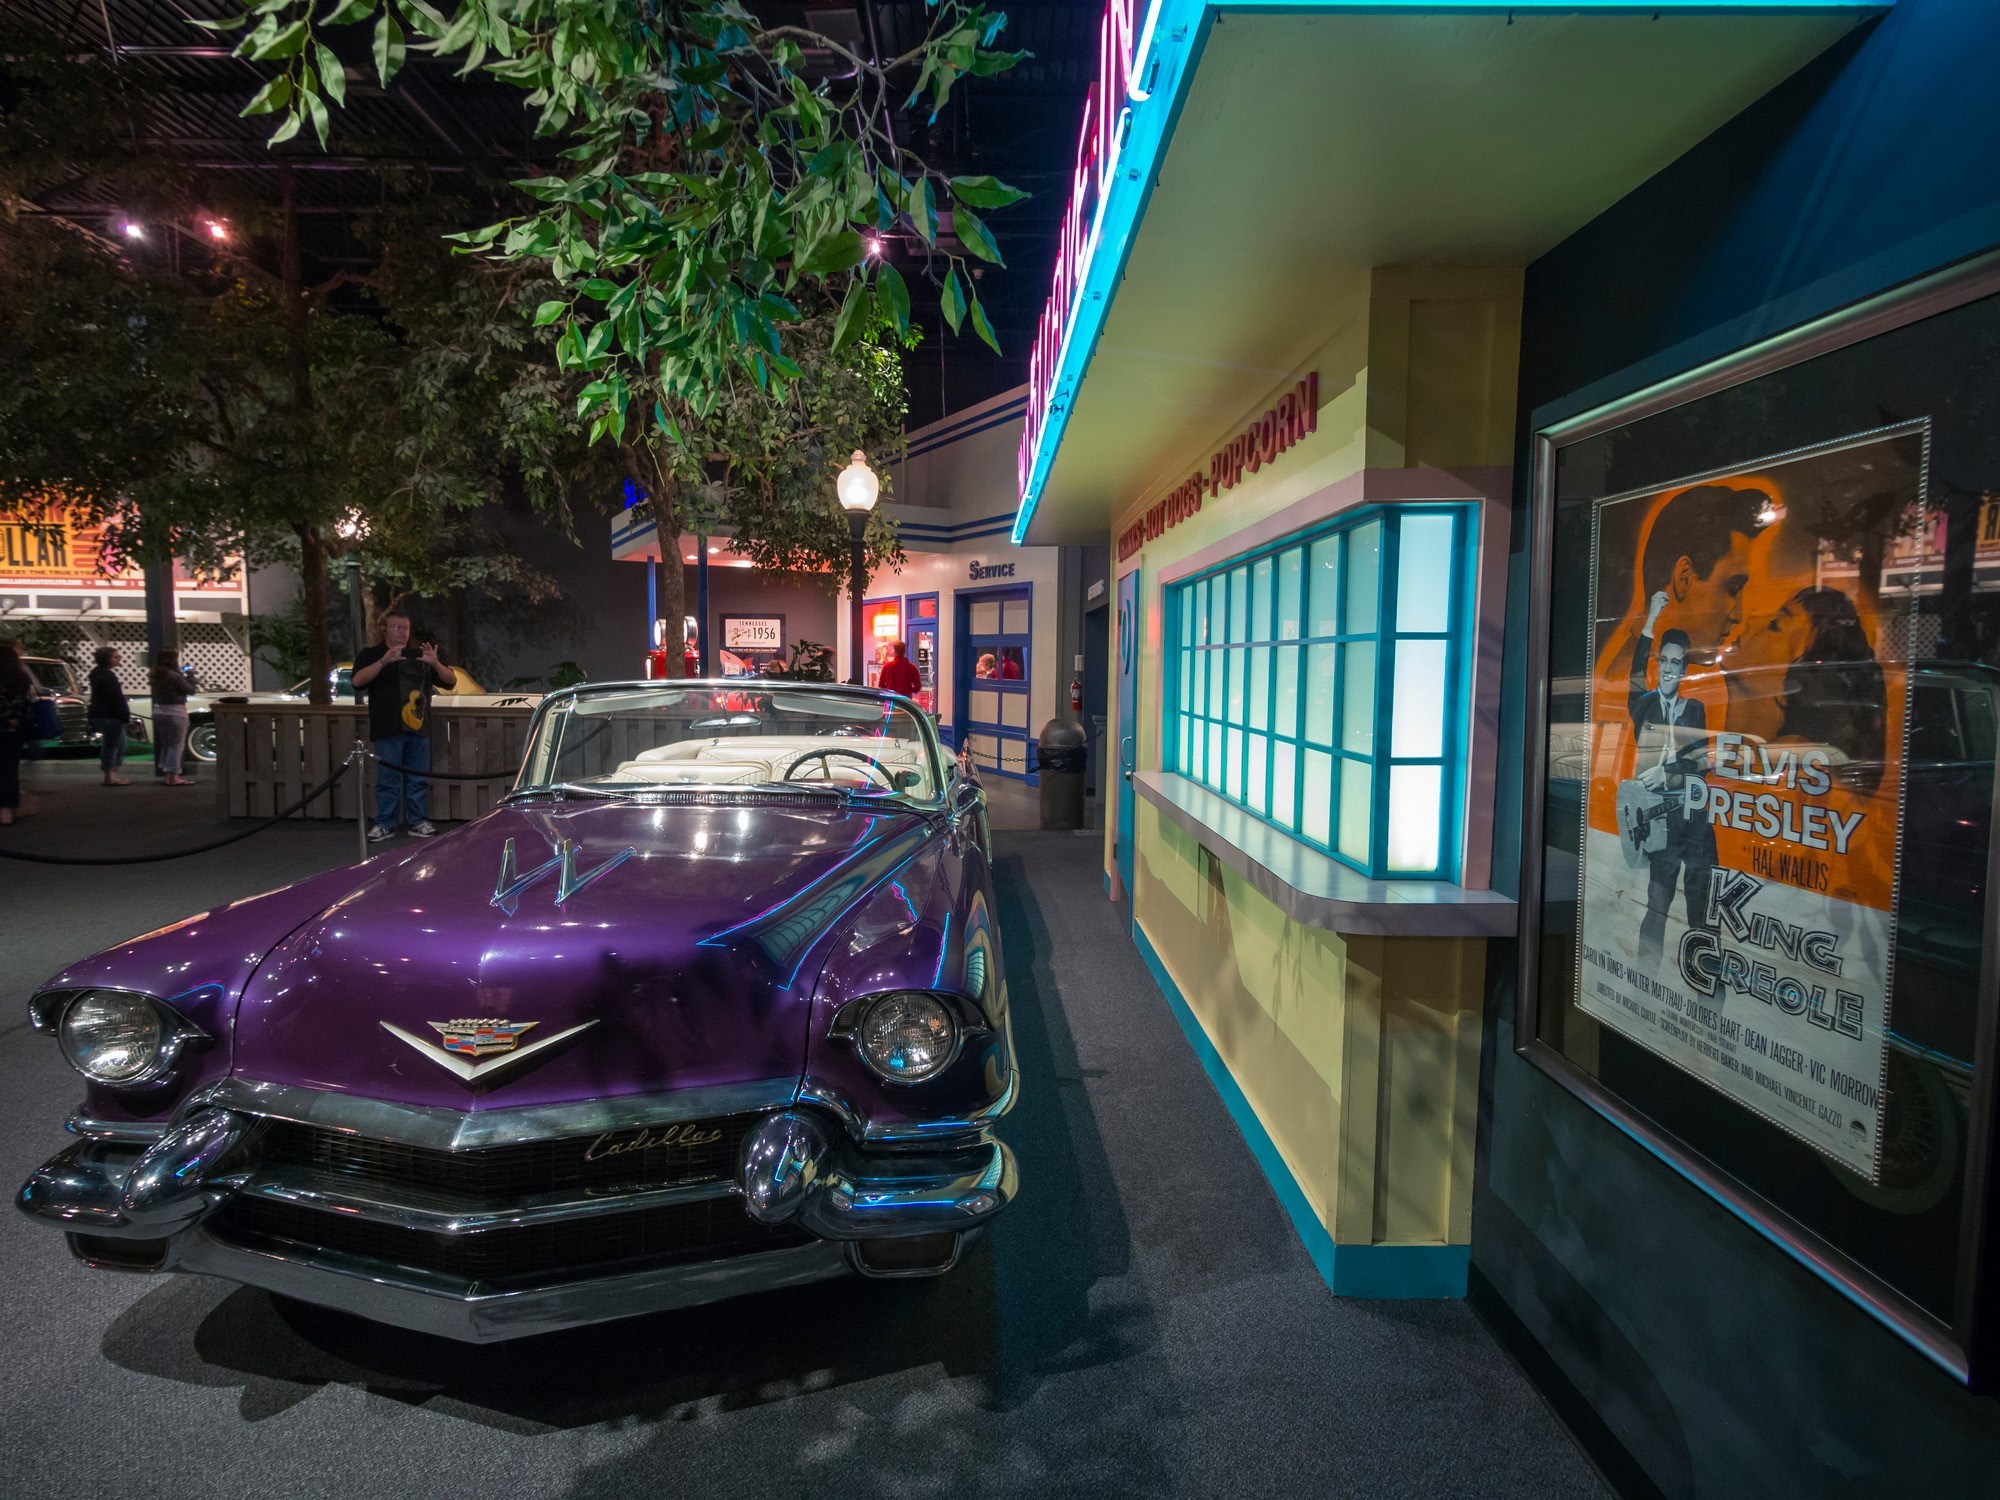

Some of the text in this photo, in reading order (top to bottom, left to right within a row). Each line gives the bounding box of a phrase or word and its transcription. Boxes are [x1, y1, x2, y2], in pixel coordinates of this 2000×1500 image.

[1167, 472, 1203, 528] DOGS
[1210, 372, 1318, 498] POPCORN
[969, 560, 1015, 580] SERVICE
[752, 627, 776, 640] 1956
[1714, 733, 1832, 796] ELVIS
[1682, 773, 1867, 855] PRESLEY
[1752, 846, 1829, 892] HAL WALLIS
[1704, 865, 1844, 978] KING
[1678, 927, 1865, 1042] CREOLE
[1626, 966, 1650, 994] WALTER
[1651, 979, 1683, 1012] MATTHAU
[1685, 999, 1717, 1031] DOLORES
[1720, 1016, 1742, 1042] HART
[1744, 1028, 1768, 1056] DEAN
[1769, 1040, 1804, 1075] JAGGER
[1810, 1058, 1826, 1085] VIC
[1741, 1062, 1754, 1081] AND
[1755, 1070, 1782, 1097] MICHAEL
[1818, 1104, 1842, 1129] GAZZO
[584, 1124, 723, 1161] Cadillac
